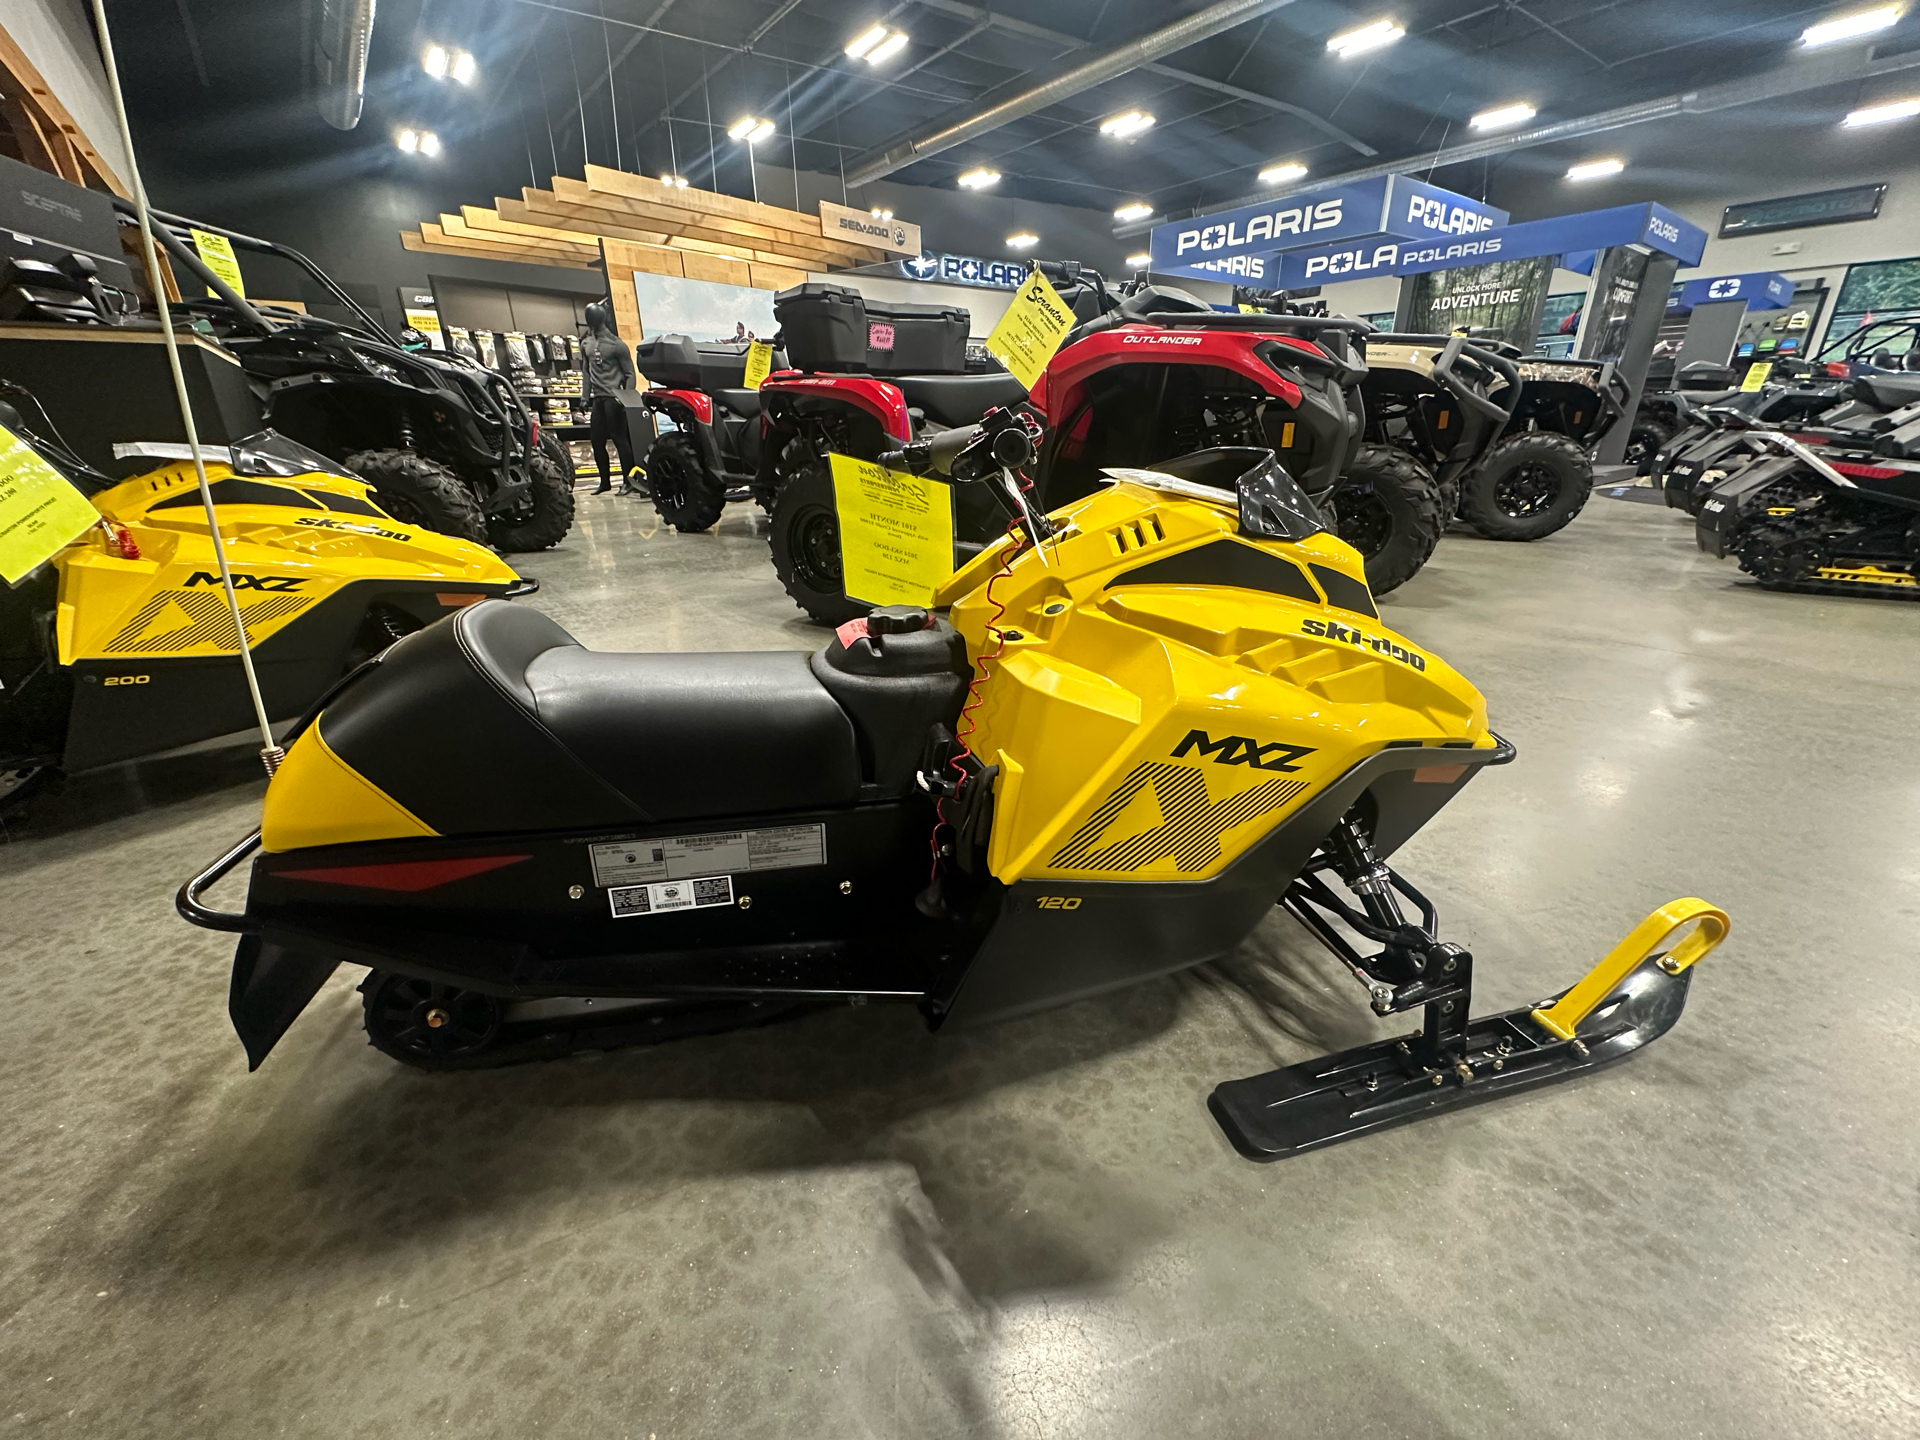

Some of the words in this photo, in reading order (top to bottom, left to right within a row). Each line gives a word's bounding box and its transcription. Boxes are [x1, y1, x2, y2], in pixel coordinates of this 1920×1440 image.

[21, 190, 83, 222] SCEPTRE
[1407, 195, 1493, 235] POLARIS
[1177, 199, 1342, 256] POLARIS
[1649, 217, 1679, 243] POLARIS
[1403, 238, 1501, 266] POLARIS
[1431, 289, 1522, 310] ADVENTURE
[1452, 284, 1480, 294] UNLOCK
[1482, 282, 1501, 290] MORE
[1026, 286, 1066, 326] Scranton
[1123, 334, 1202, 346] OUTLANDER
[183, 571, 312, 592] MXZ
[1302, 617, 1426, 672] ski-doo
[103, 674, 150, 687] 200
[1170, 729, 1318, 772] MXZ
[1036, 896, 1081, 910] 120
